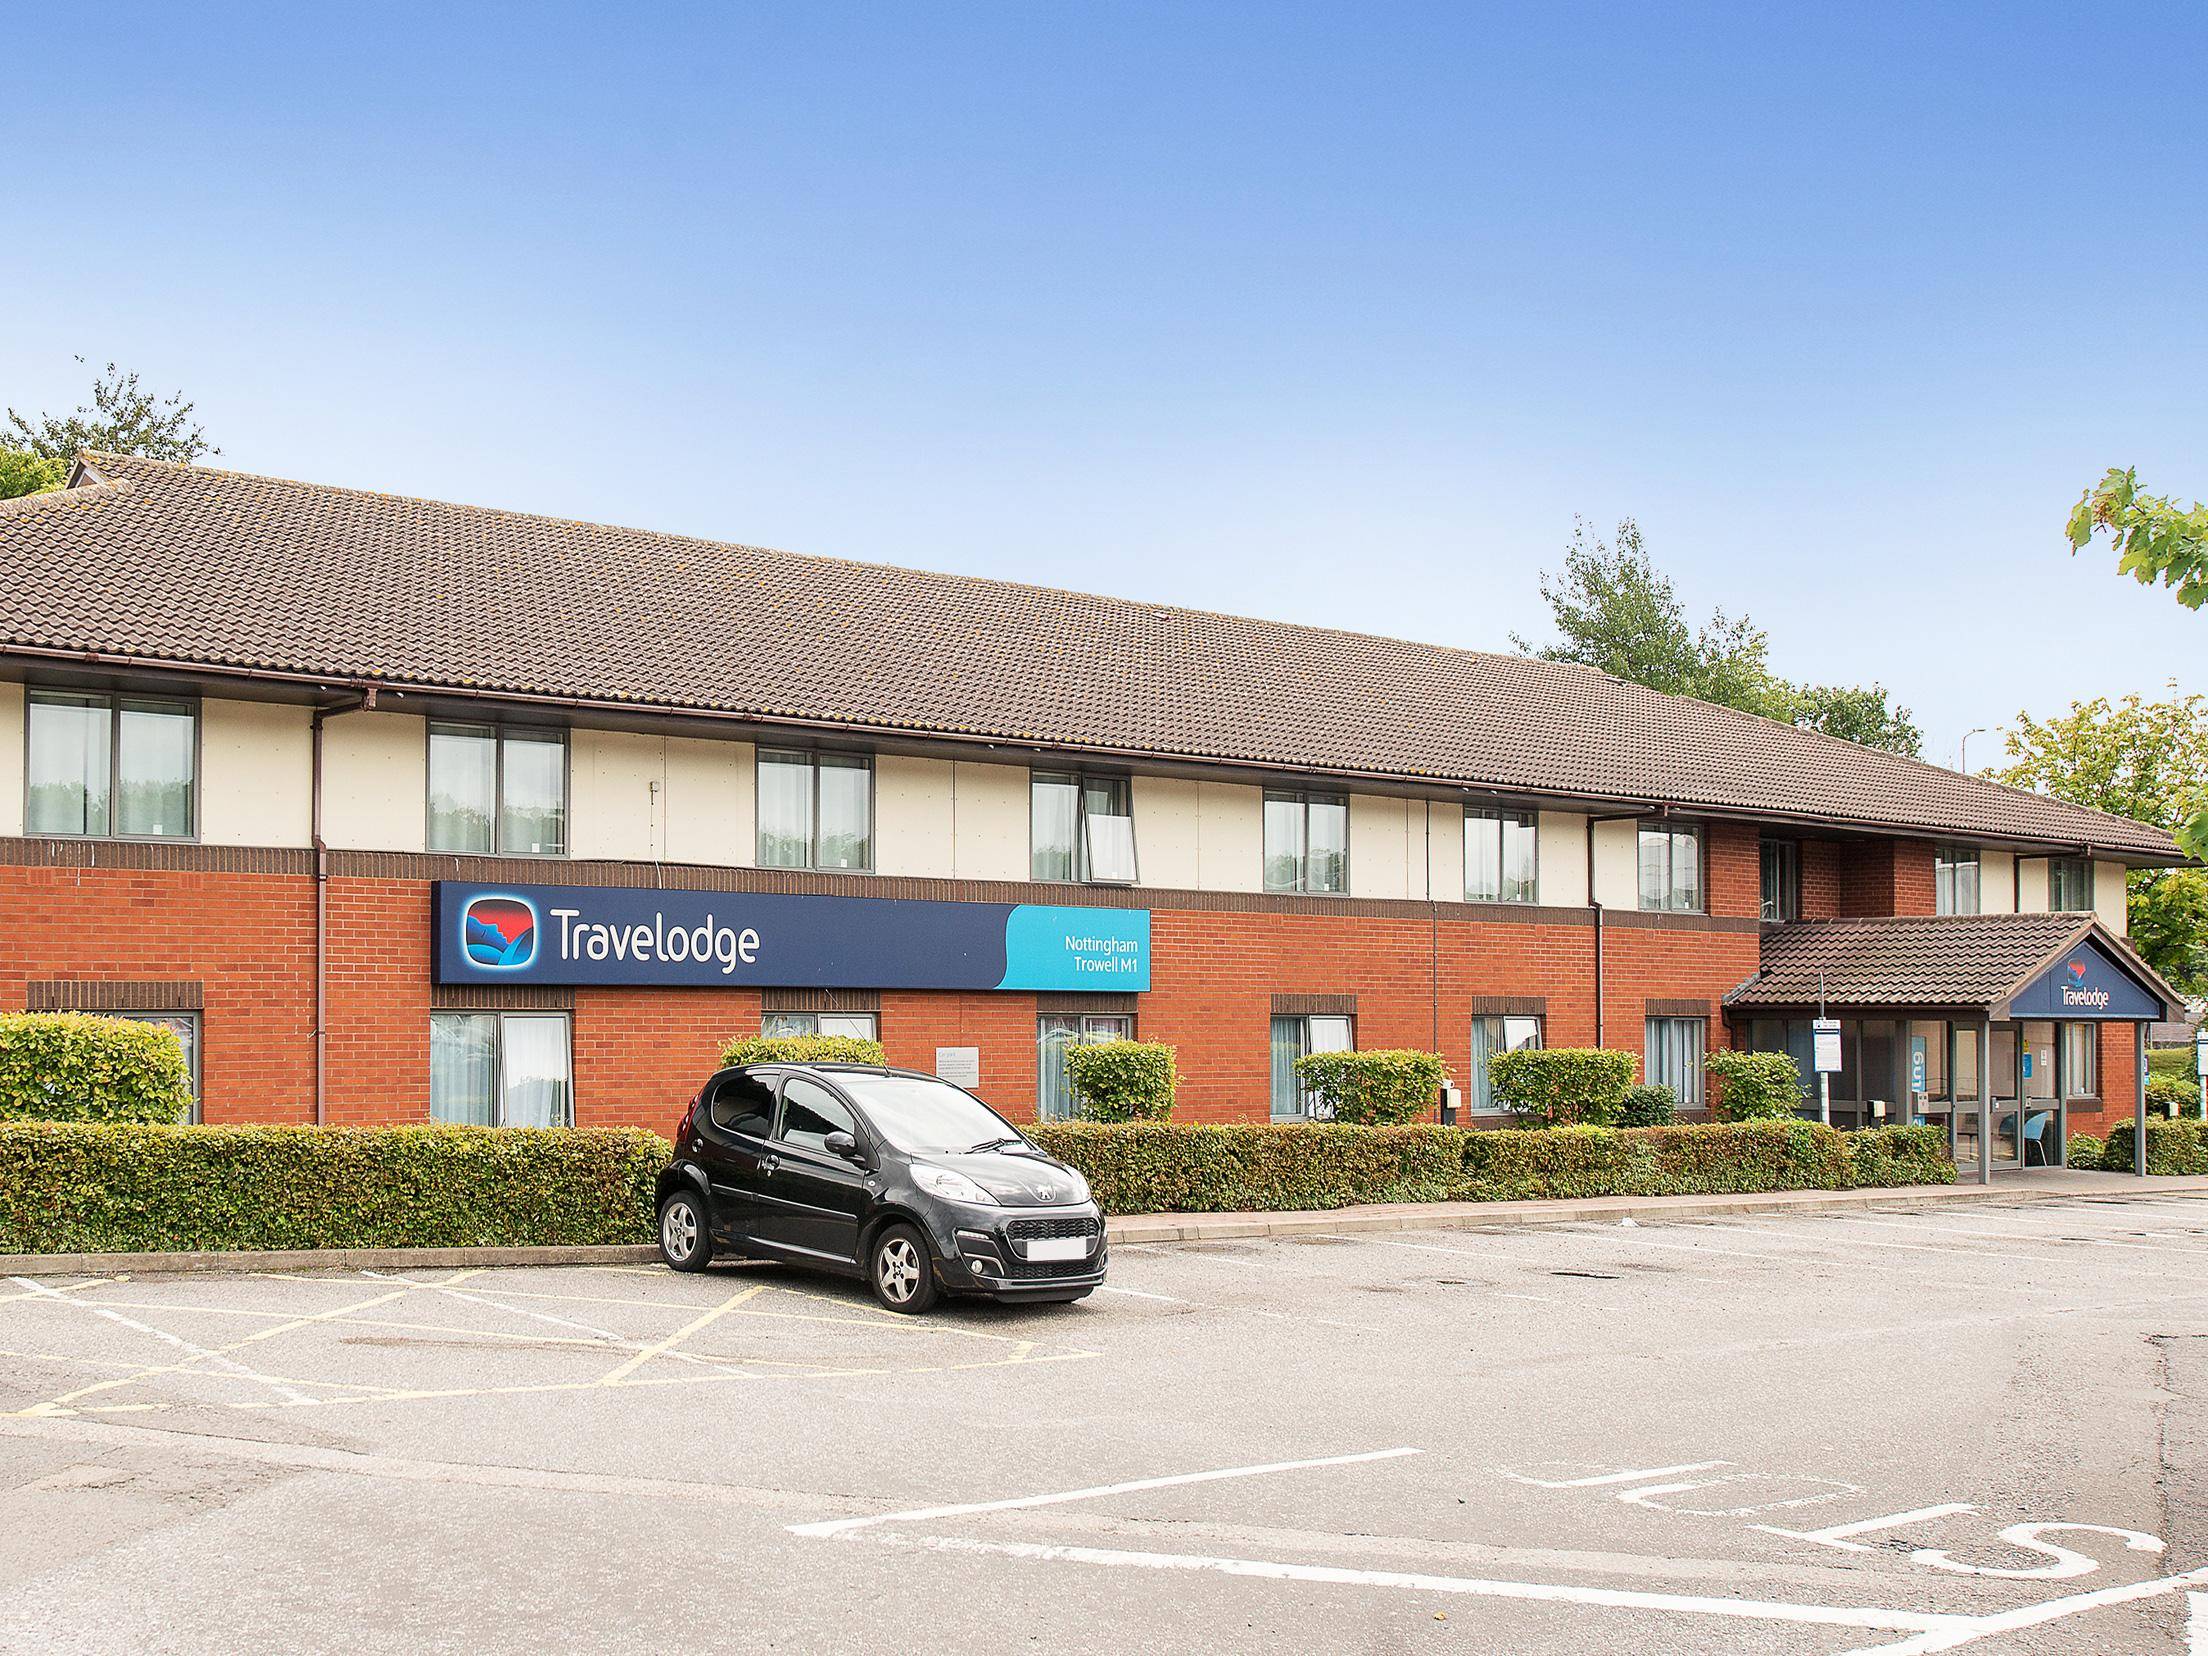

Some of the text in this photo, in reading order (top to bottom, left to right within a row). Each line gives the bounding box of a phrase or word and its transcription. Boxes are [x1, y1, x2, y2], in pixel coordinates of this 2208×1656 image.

[550, 908, 760, 974] Travelodge
[1065, 935, 1138, 956] Nottingham
[1074, 956, 1138, 973] Trowell M1
[2060, 985, 2109, 1010] Travelodge
